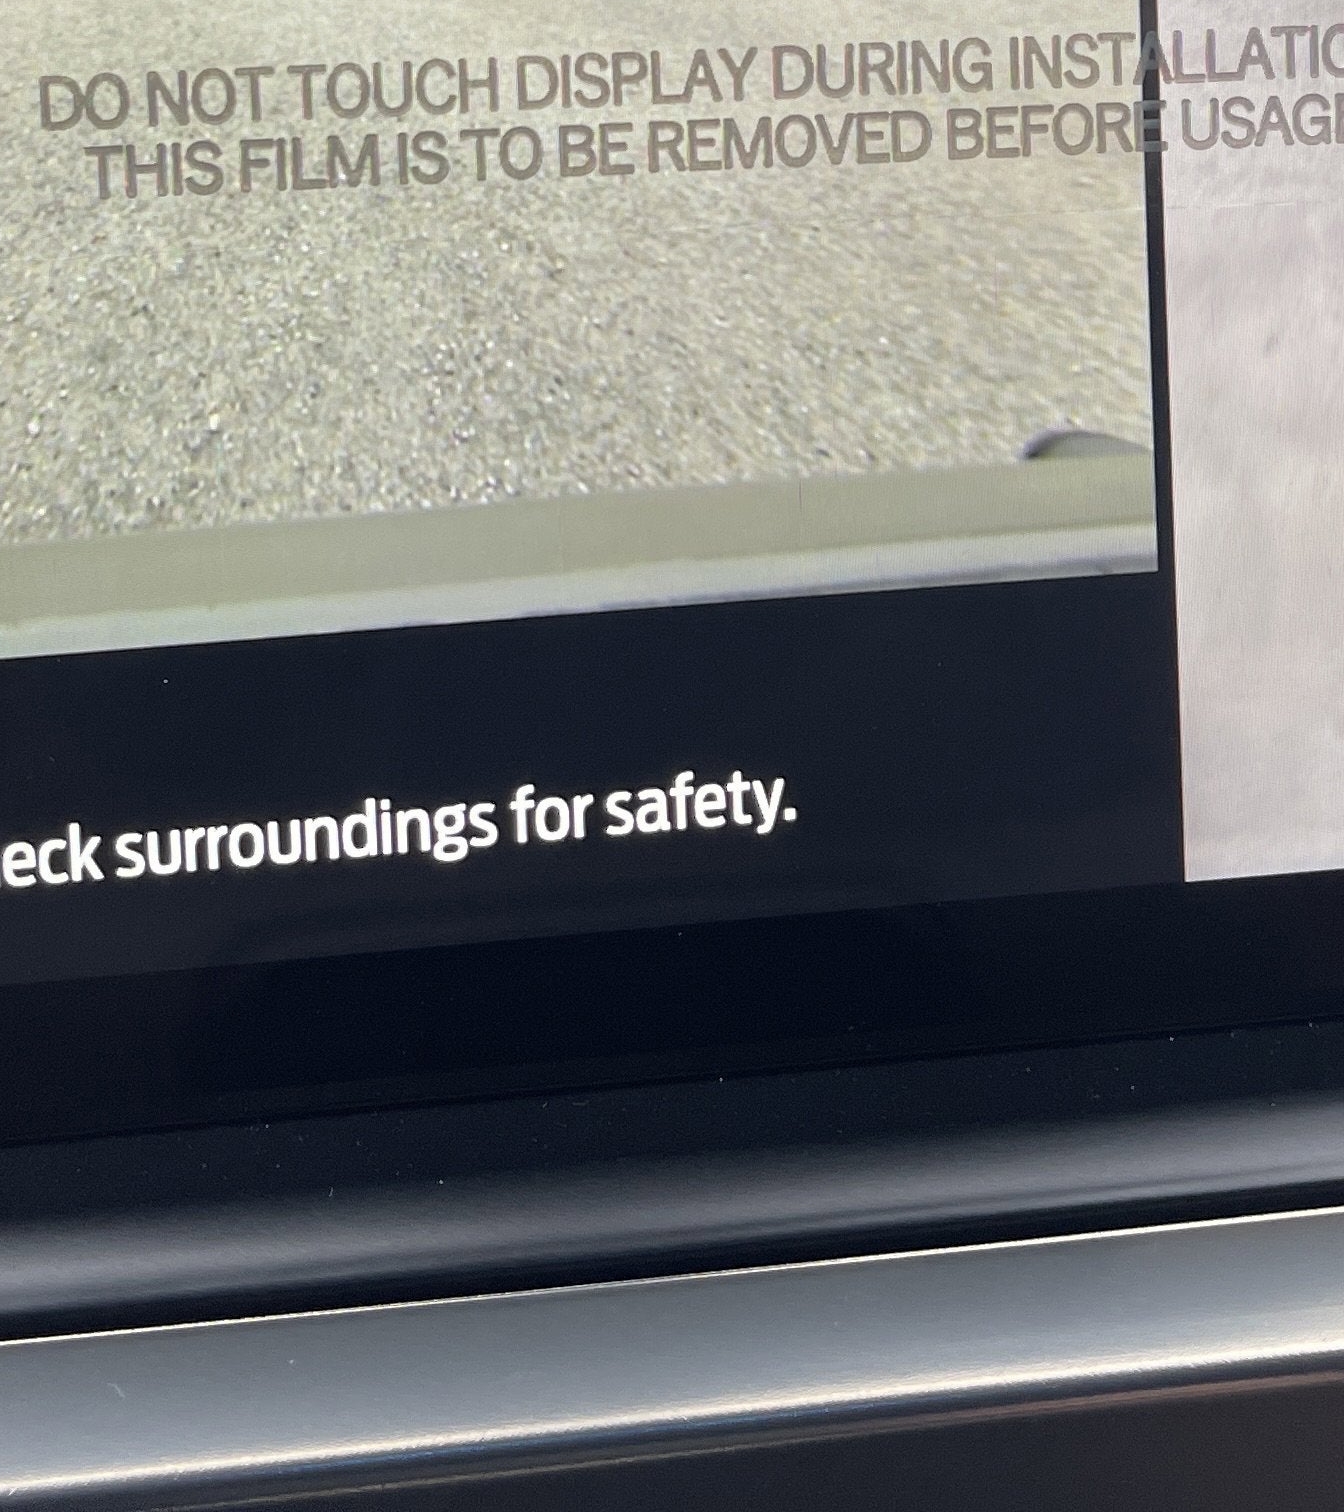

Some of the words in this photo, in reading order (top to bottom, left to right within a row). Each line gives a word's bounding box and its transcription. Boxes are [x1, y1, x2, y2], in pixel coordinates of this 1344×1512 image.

[39, 72, 130, 131] DO
[146, 65, 275, 128] NOT
[287, 56, 500, 121] TOUCH
[516, 45, 758, 112] DISPLAY
[771, 36, 993, 101] DURING
[84, 140, 224, 200] THIS
[239, 133, 382, 192] FILM
[397, 130, 450, 187] IS
[461, 125, 542, 182] TO
[558, 122, 635, 178] BE
[647, 109, 933, 174] REMOVED
[947, 99, 1168, 161] BEFORE
[114, 794, 500, 879] surroundings
[509, 784, 594, 844] for
[604, 770, 799, 835] safety.
